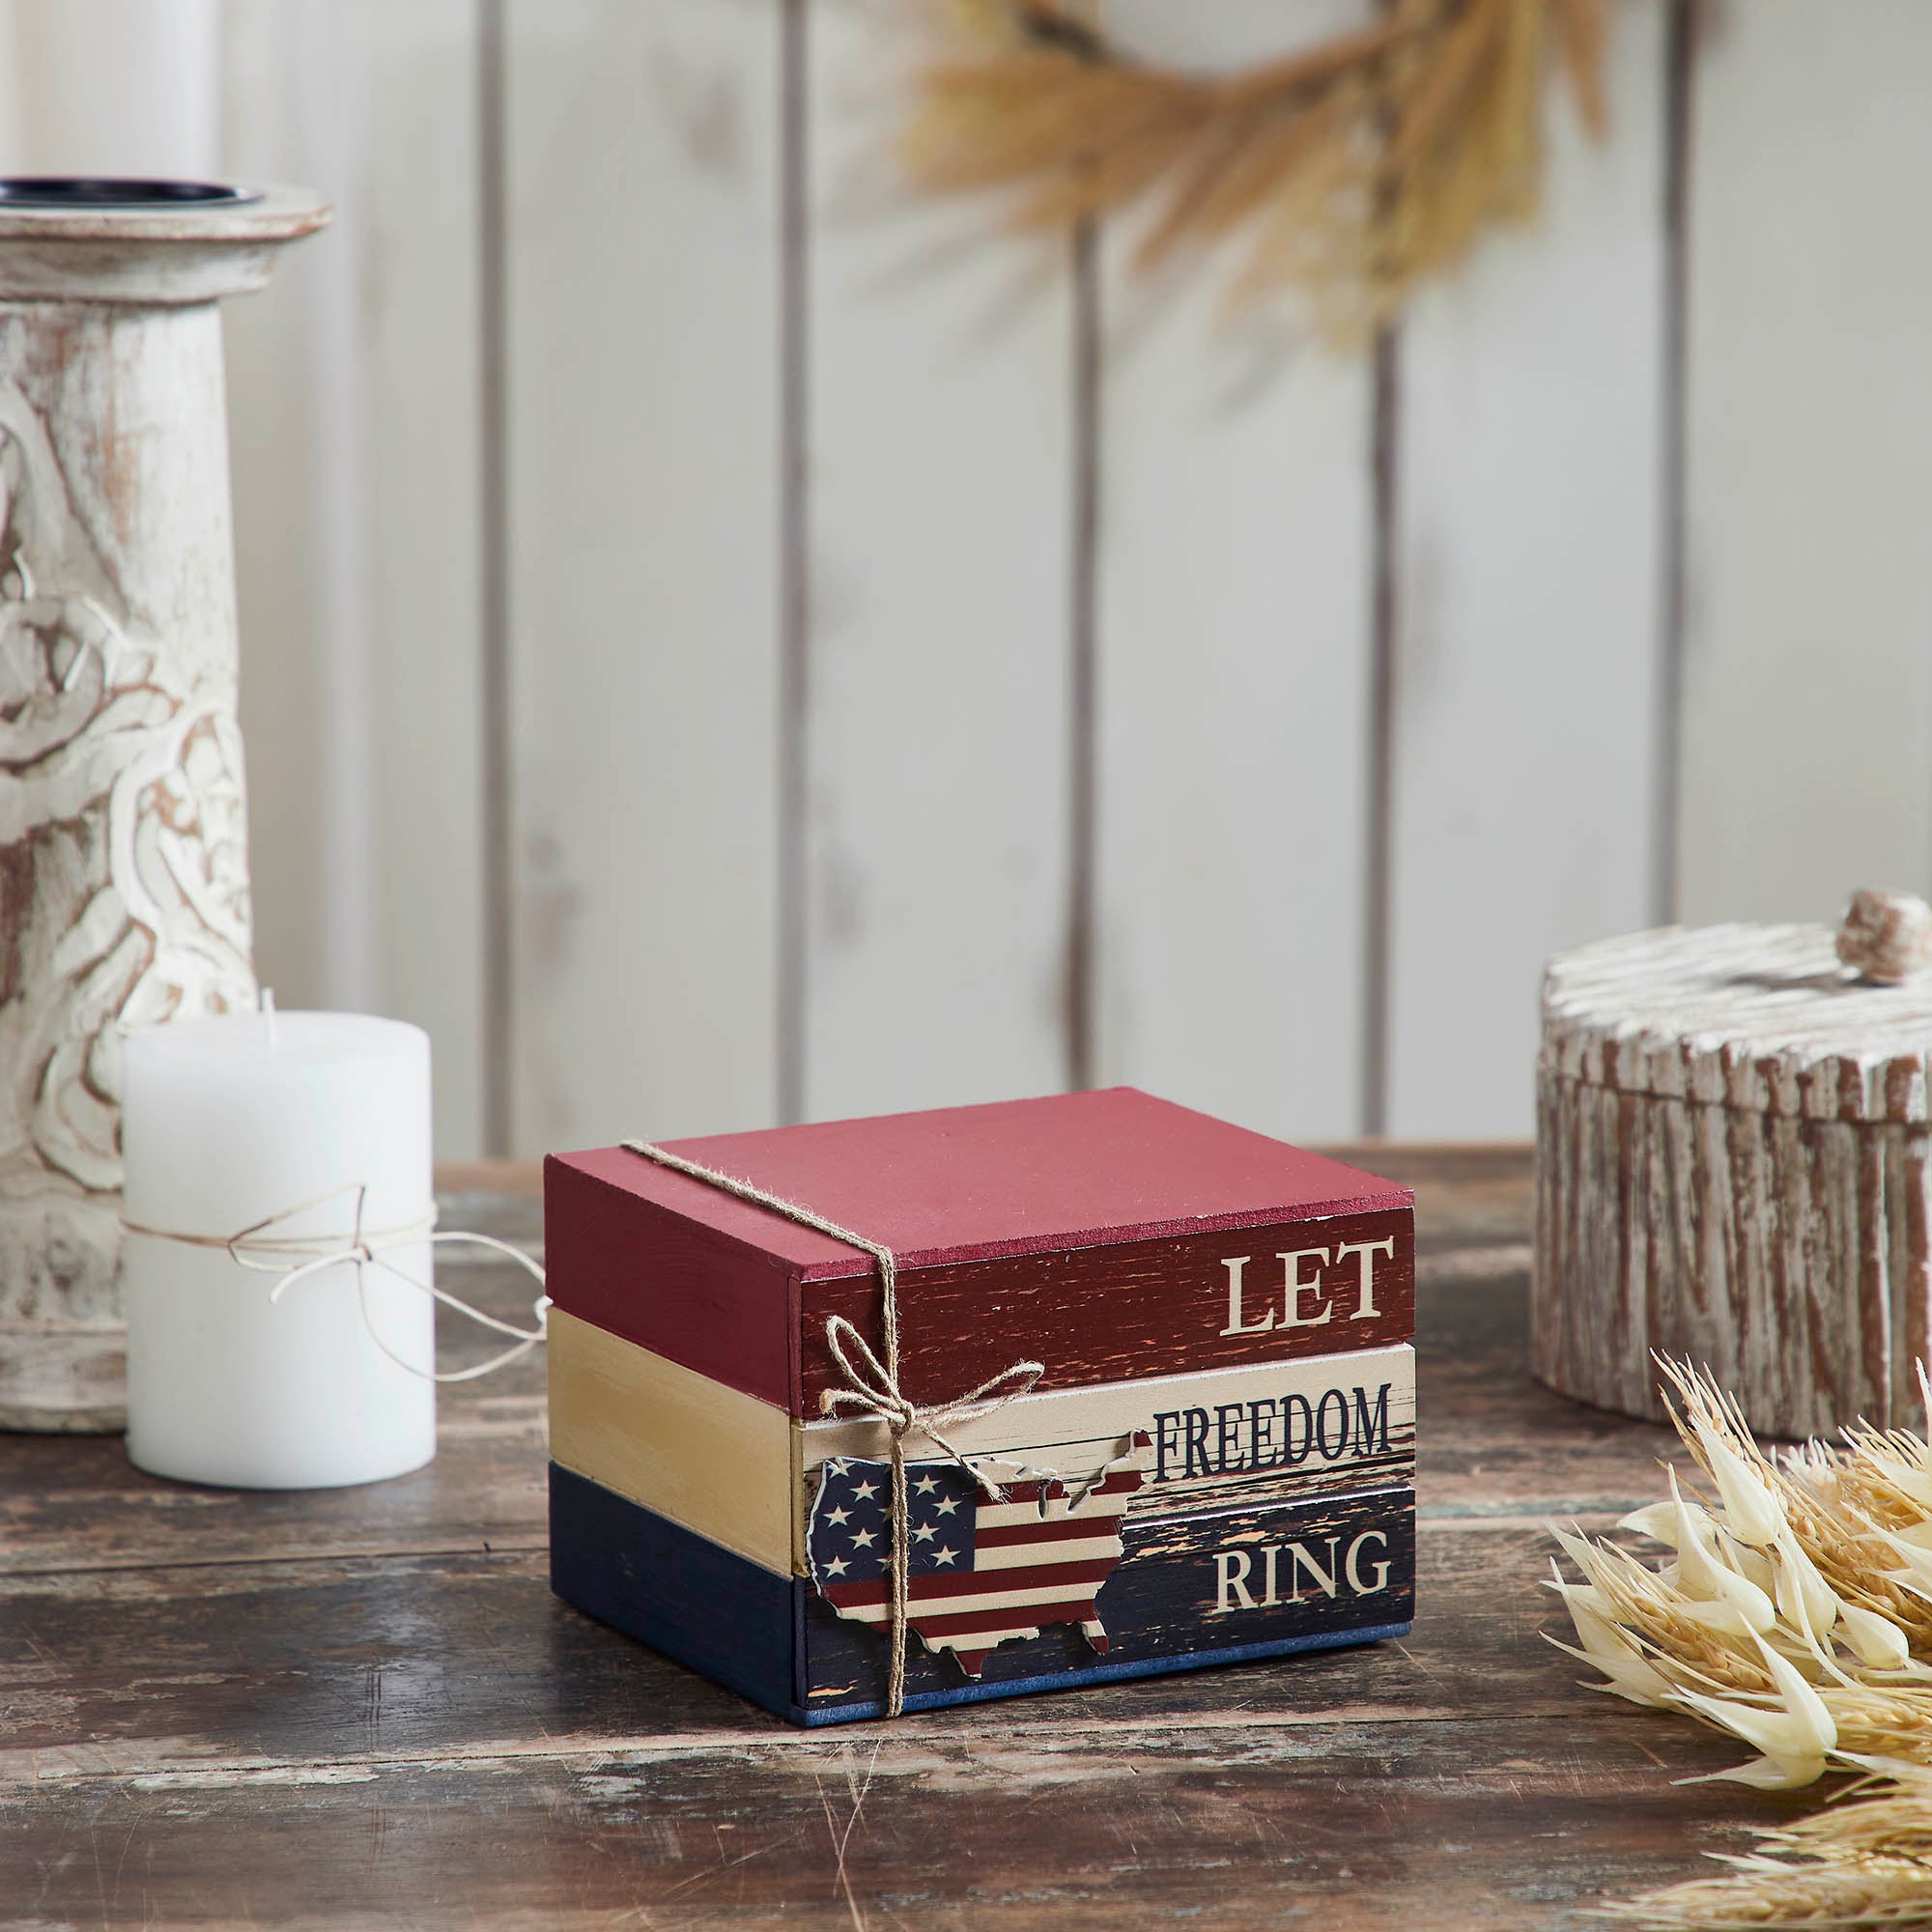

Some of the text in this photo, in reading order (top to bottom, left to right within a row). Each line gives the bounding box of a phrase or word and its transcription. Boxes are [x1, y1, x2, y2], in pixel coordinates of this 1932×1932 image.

[1219, 1235, 1395, 1337] LET
[1152, 1382, 1392, 1484] FREEDOM
[1209, 1530, 1392, 1615] RING
